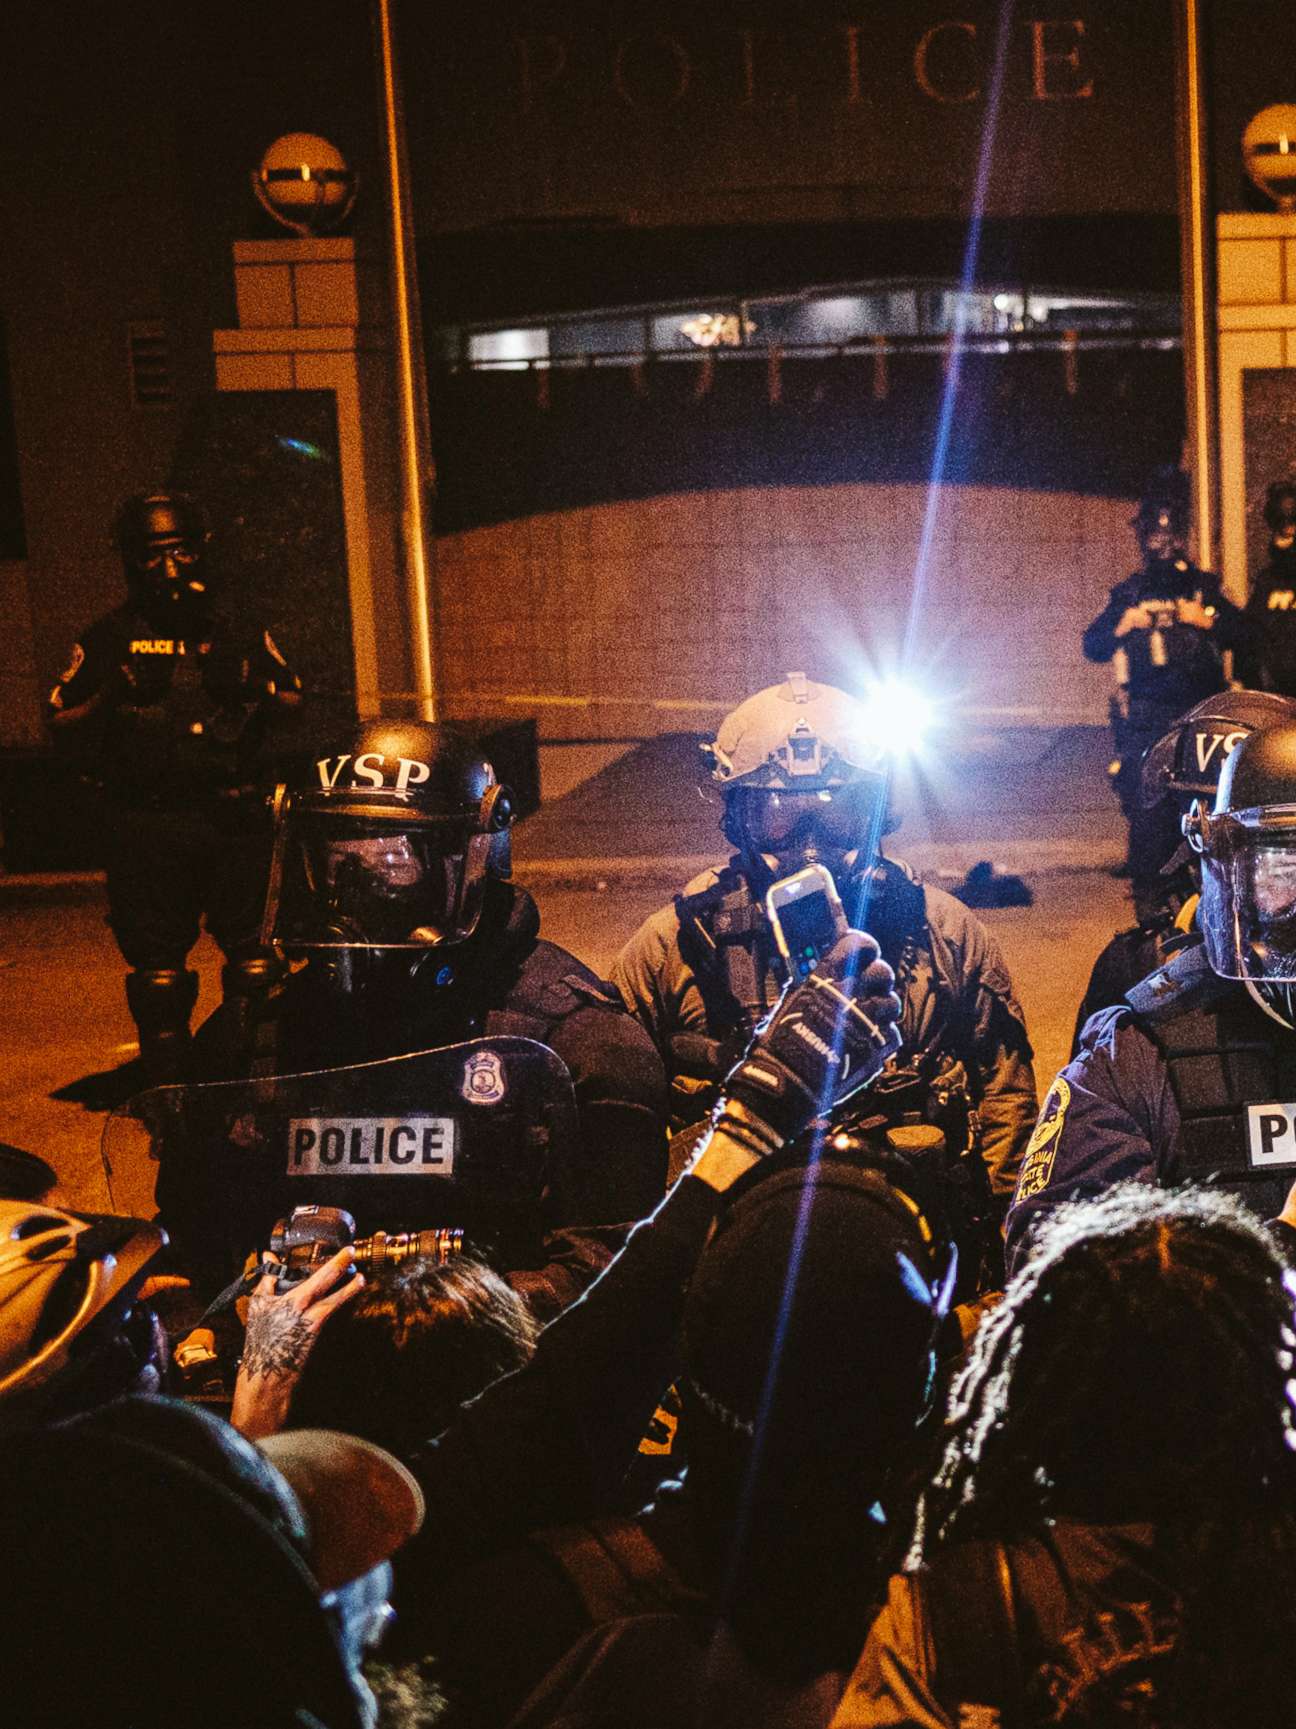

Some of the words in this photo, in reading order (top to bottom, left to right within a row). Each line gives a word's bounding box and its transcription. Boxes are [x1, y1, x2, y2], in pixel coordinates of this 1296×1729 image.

[510, 18, 1096, 110] POLICE
[130, 638, 175, 655] POLICE
[316, 753, 431, 802] VSP
[294, 1126, 444, 1165] POLICE
